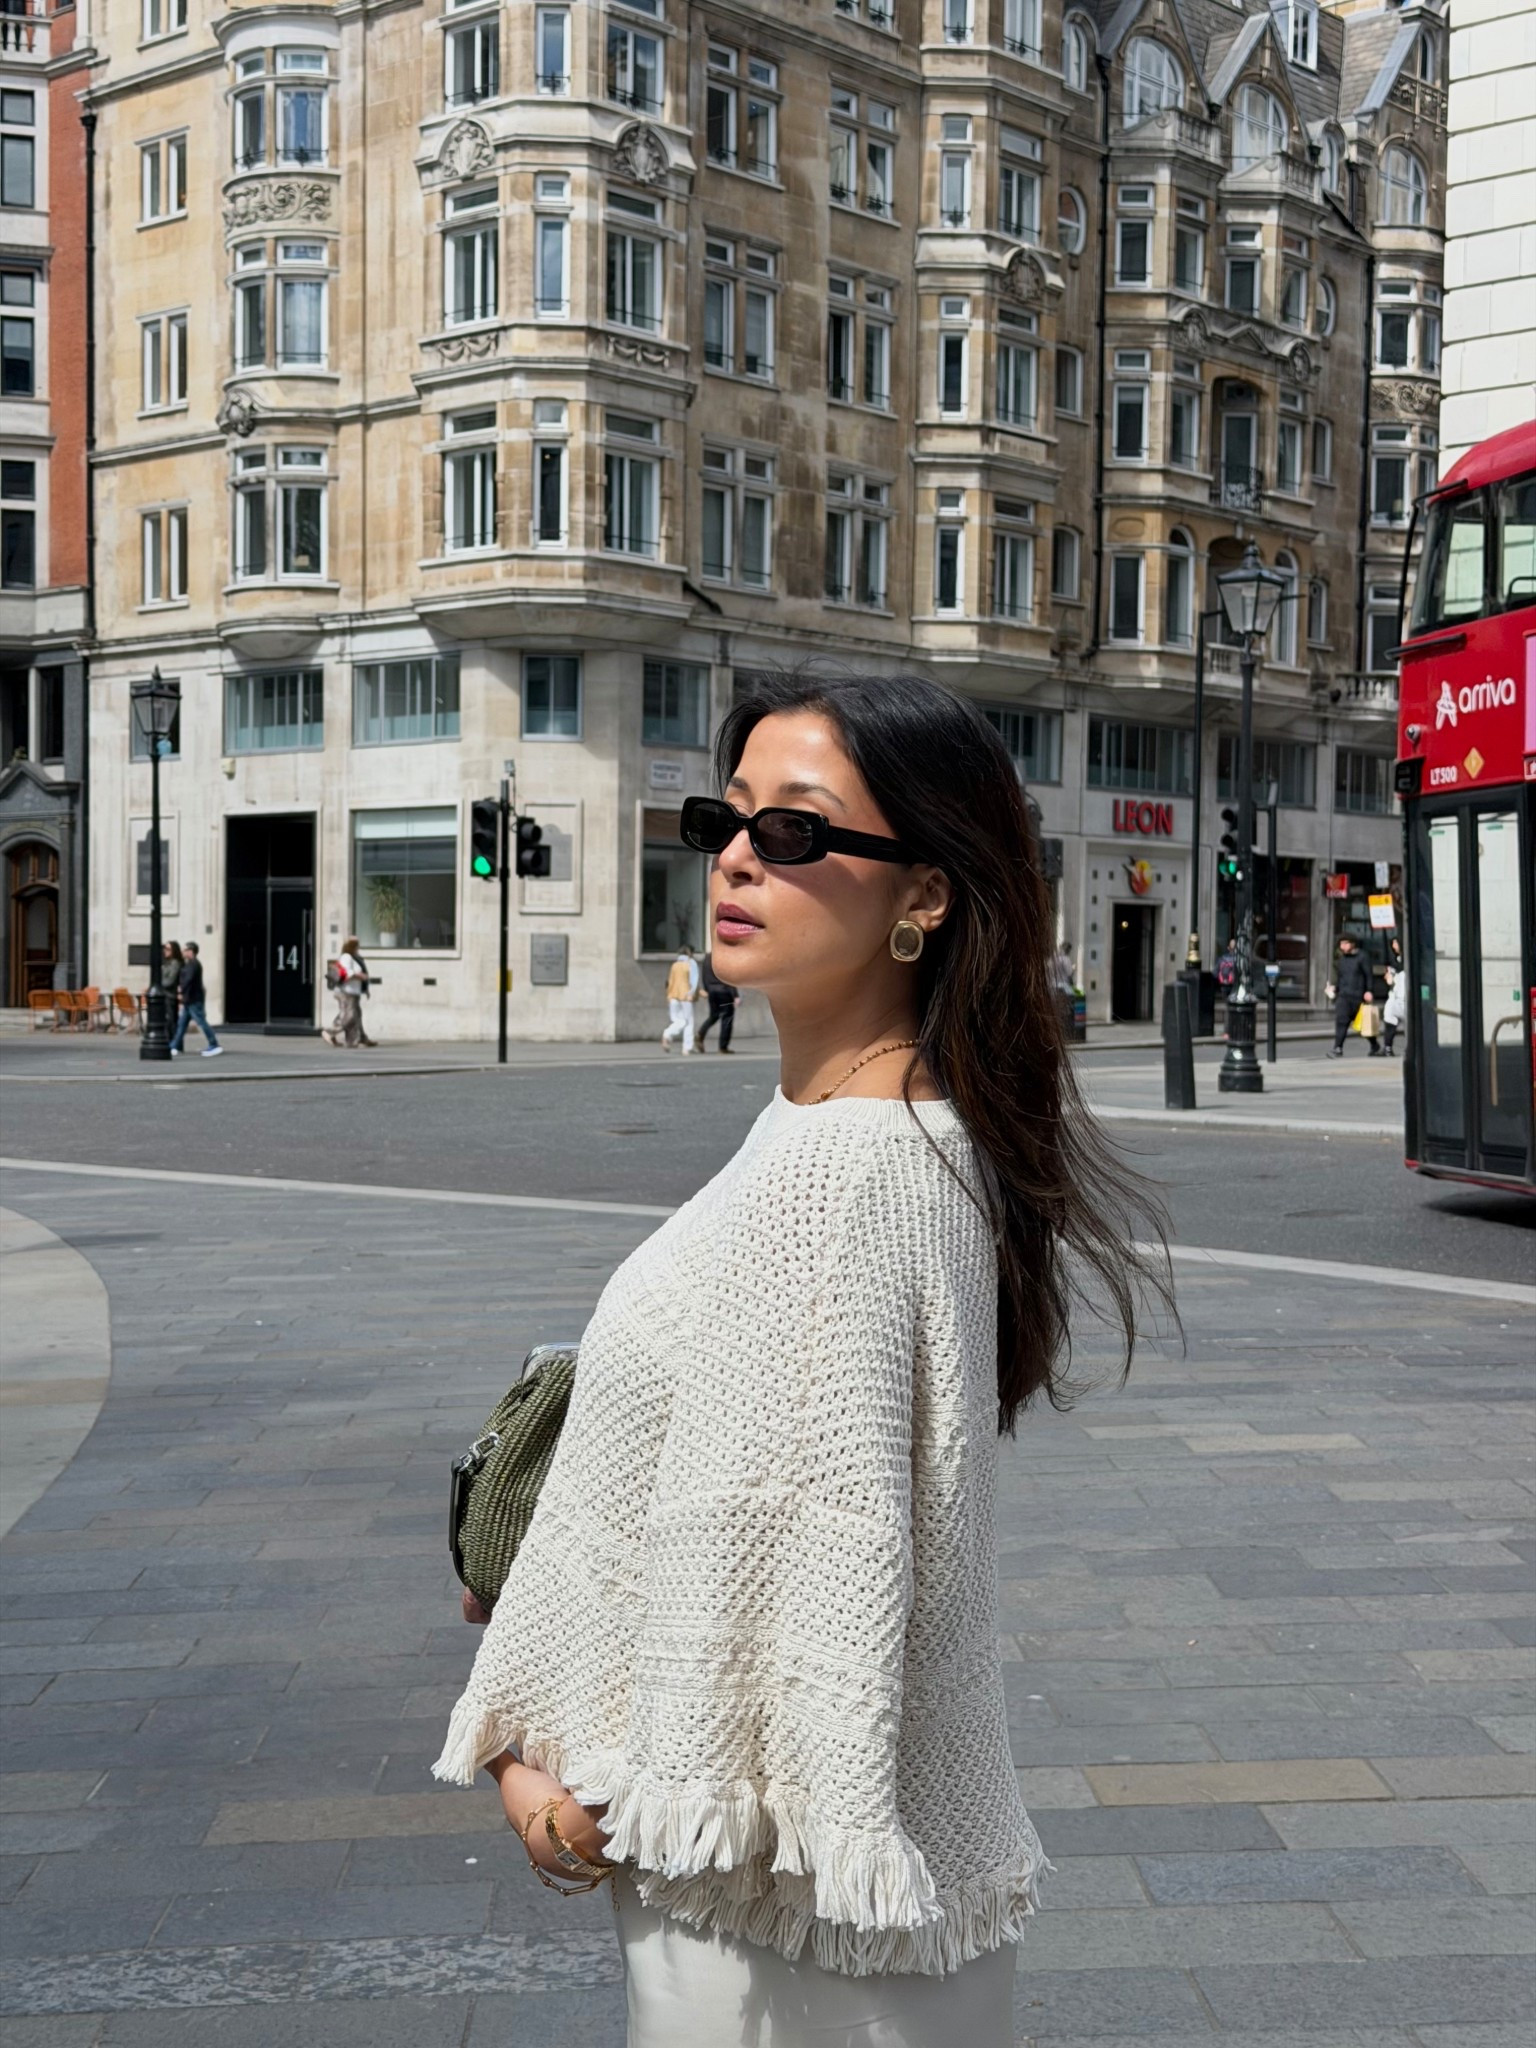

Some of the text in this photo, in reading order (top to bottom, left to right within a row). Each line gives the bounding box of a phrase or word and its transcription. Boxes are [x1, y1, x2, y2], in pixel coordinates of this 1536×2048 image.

[1458, 674, 1516, 714] arriva
[1112, 798, 1174, 836] LEON
[277, 944, 300, 971] 14
